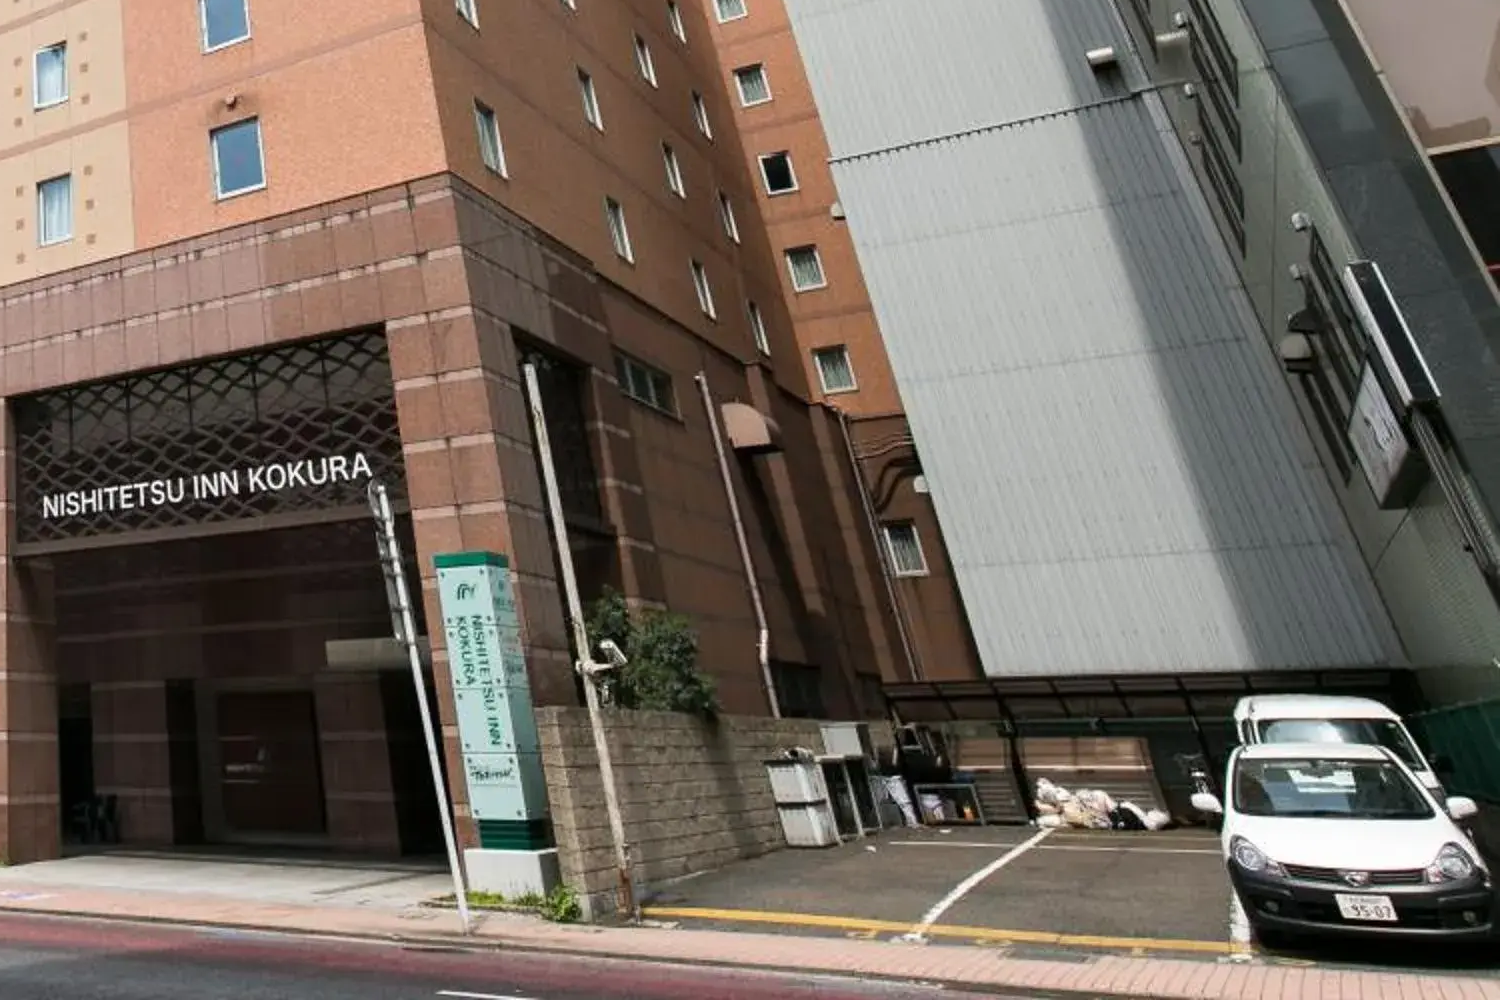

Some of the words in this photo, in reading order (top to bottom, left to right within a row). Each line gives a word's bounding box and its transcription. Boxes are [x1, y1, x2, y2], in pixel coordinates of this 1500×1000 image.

[43, 477, 185, 518] NISHITETSU
[193, 470, 239, 499] INN
[249, 452, 373, 493] KOKURA
[456, 616, 476, 686] KOKURA
[471, 615, 495, 711] NISHITETSU
[487, 716, 502, 747] INN
